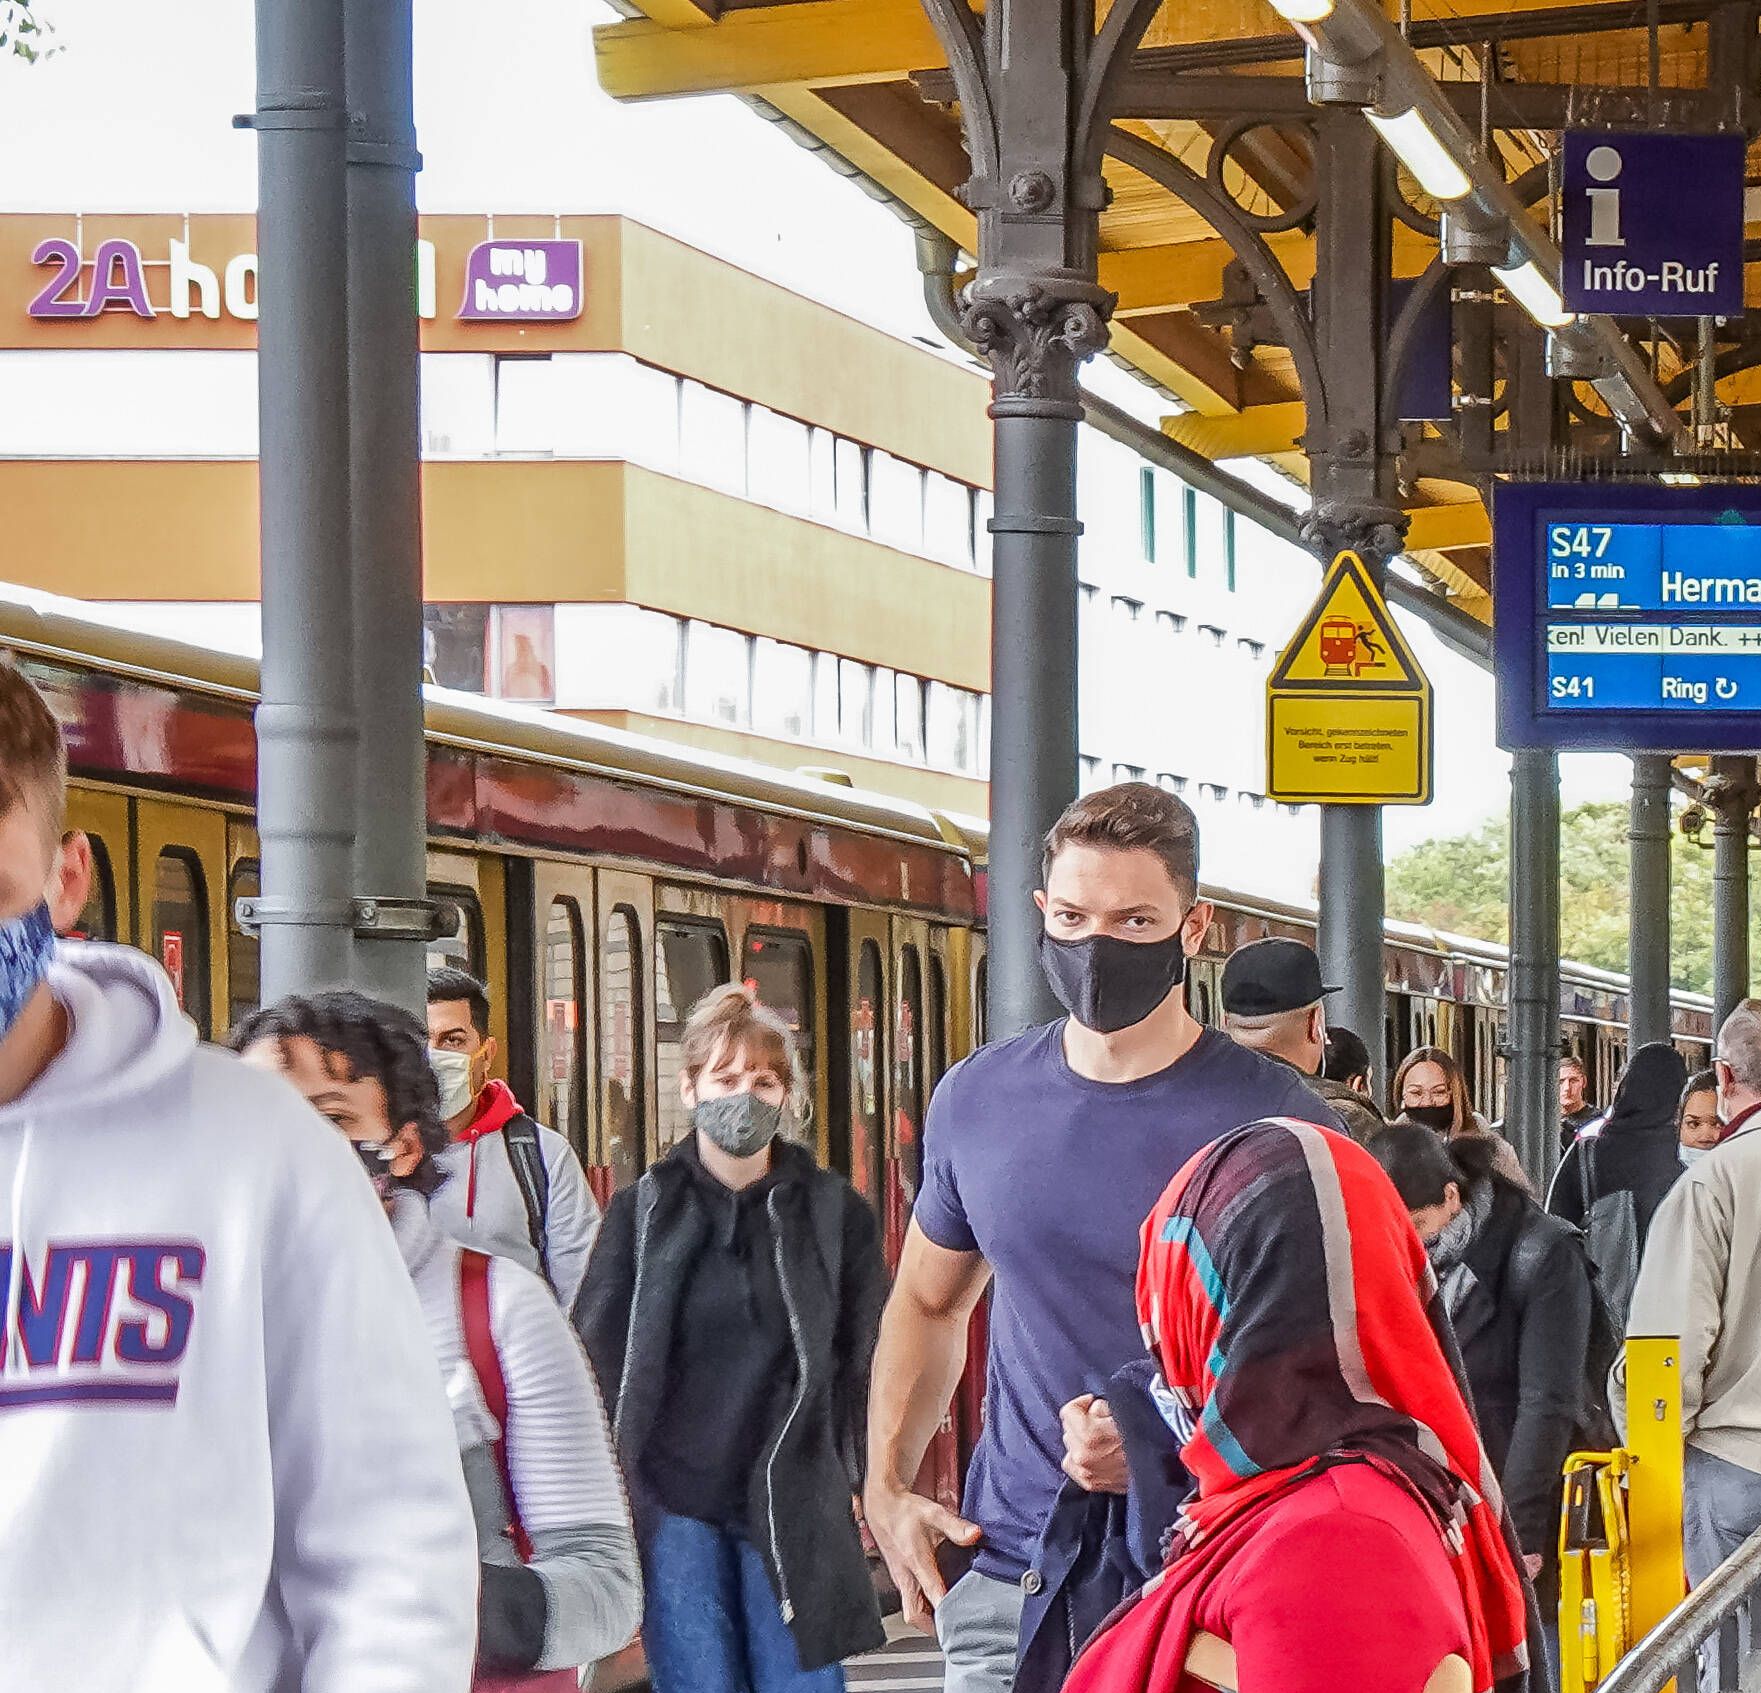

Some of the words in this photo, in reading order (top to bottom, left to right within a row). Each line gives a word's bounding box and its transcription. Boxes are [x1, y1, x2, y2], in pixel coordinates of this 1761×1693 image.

[29, 238, 158, 318] 2A
[489, 248, 546, 285] my
[1584, 259, 1719, 293] Info-Ruf
[475, 279, 573, 313] home
[1551, 527, 1612, 558] S47
[1551, 562, 1569, 578] in
[1574, 562, 1586, 578] 3
[1590, 562, 1625, 578] min
[1596, 626, 1659, 646] Vielen
[1670, 626, 1728, 646] Dank.
[1551, 676, 1595, 698] S41
[1661, 676, 1708, 703] Ring
